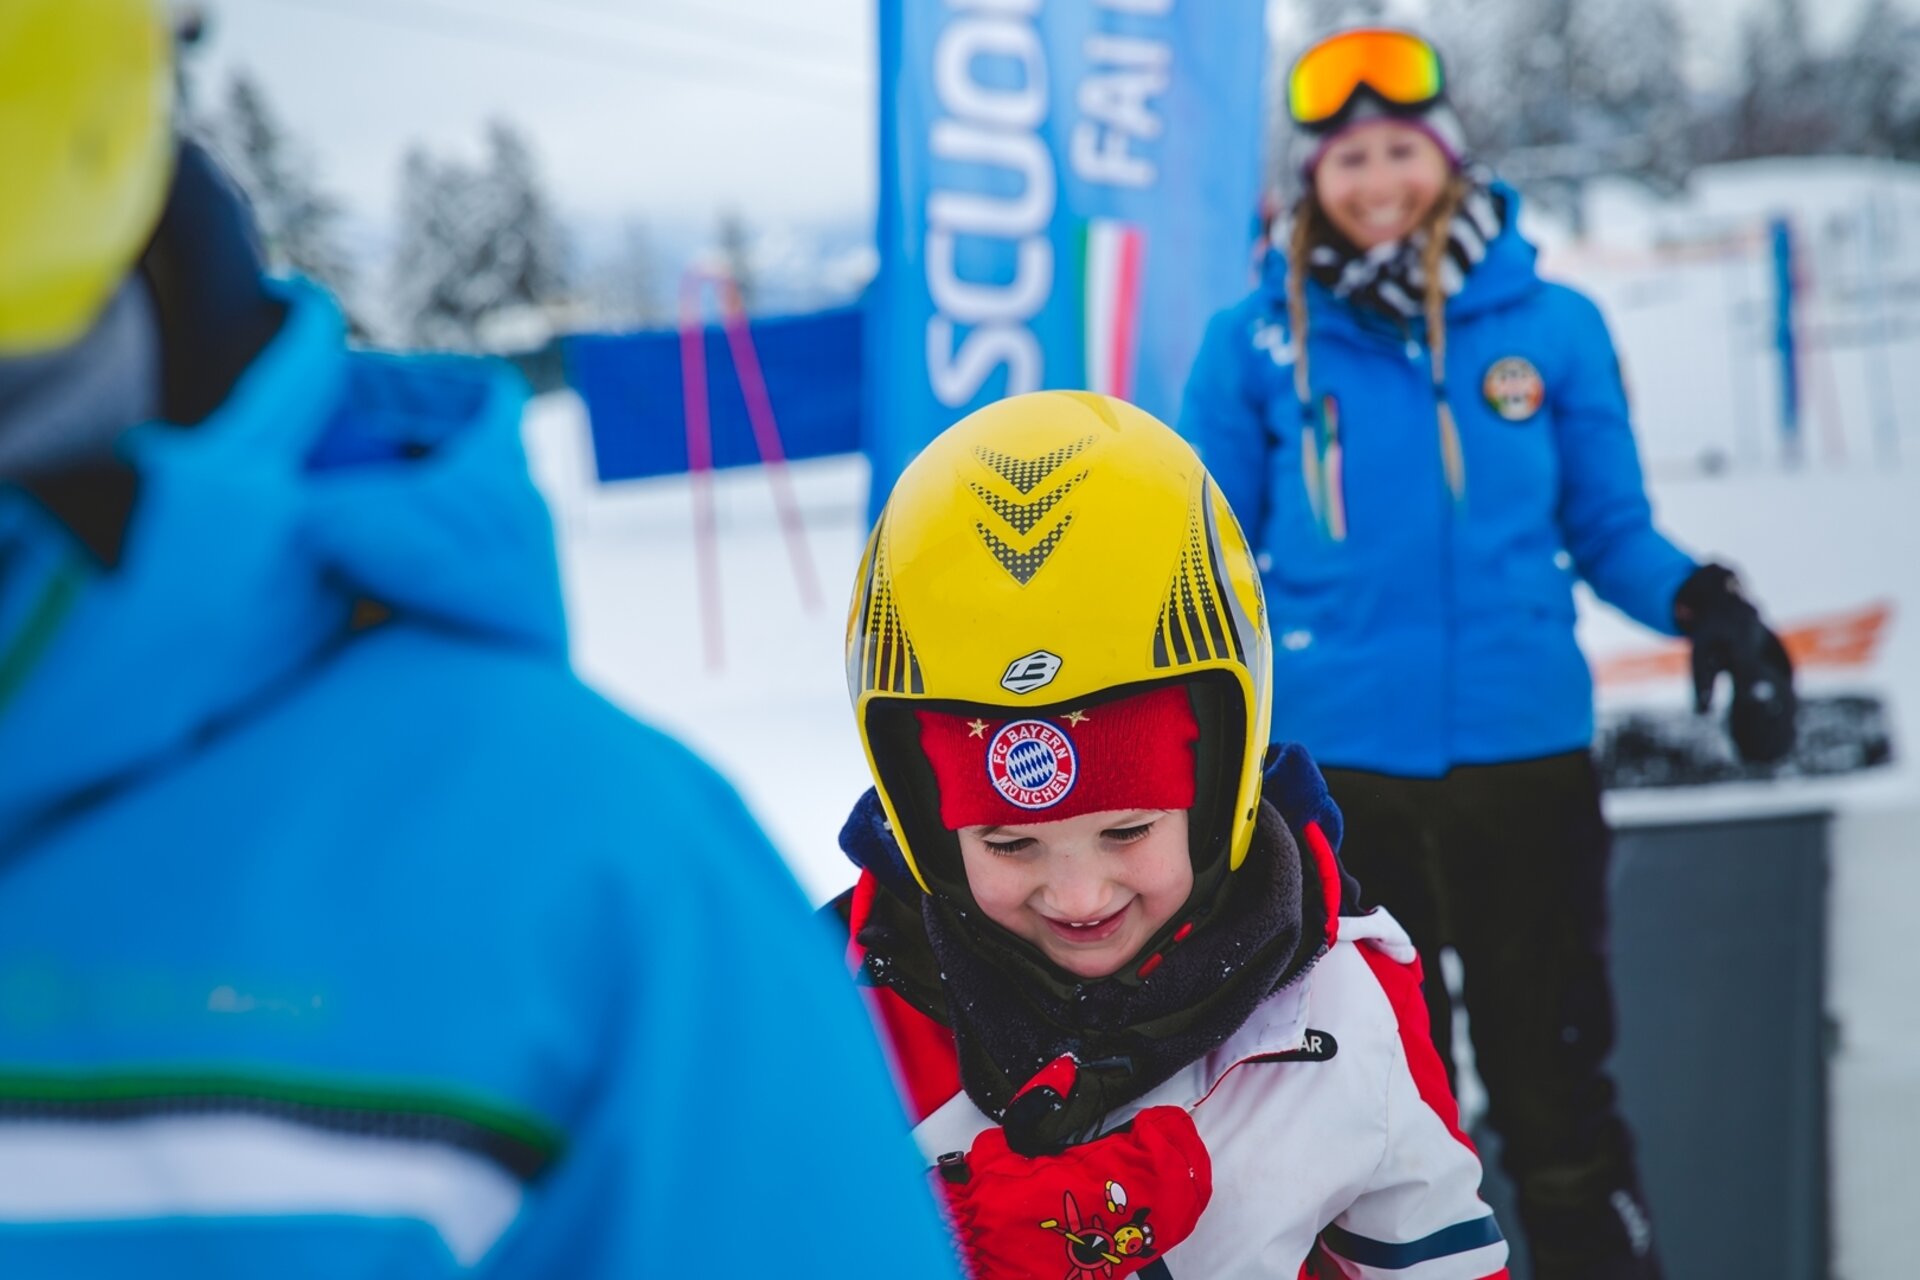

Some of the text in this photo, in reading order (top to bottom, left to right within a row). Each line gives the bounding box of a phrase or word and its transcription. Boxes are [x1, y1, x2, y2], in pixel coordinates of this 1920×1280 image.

[1069, 34, 1173, 189] FAI
[925, 0, 1057, 408] SCUO
[993, 725, 1069, 765] FC BAYERN
